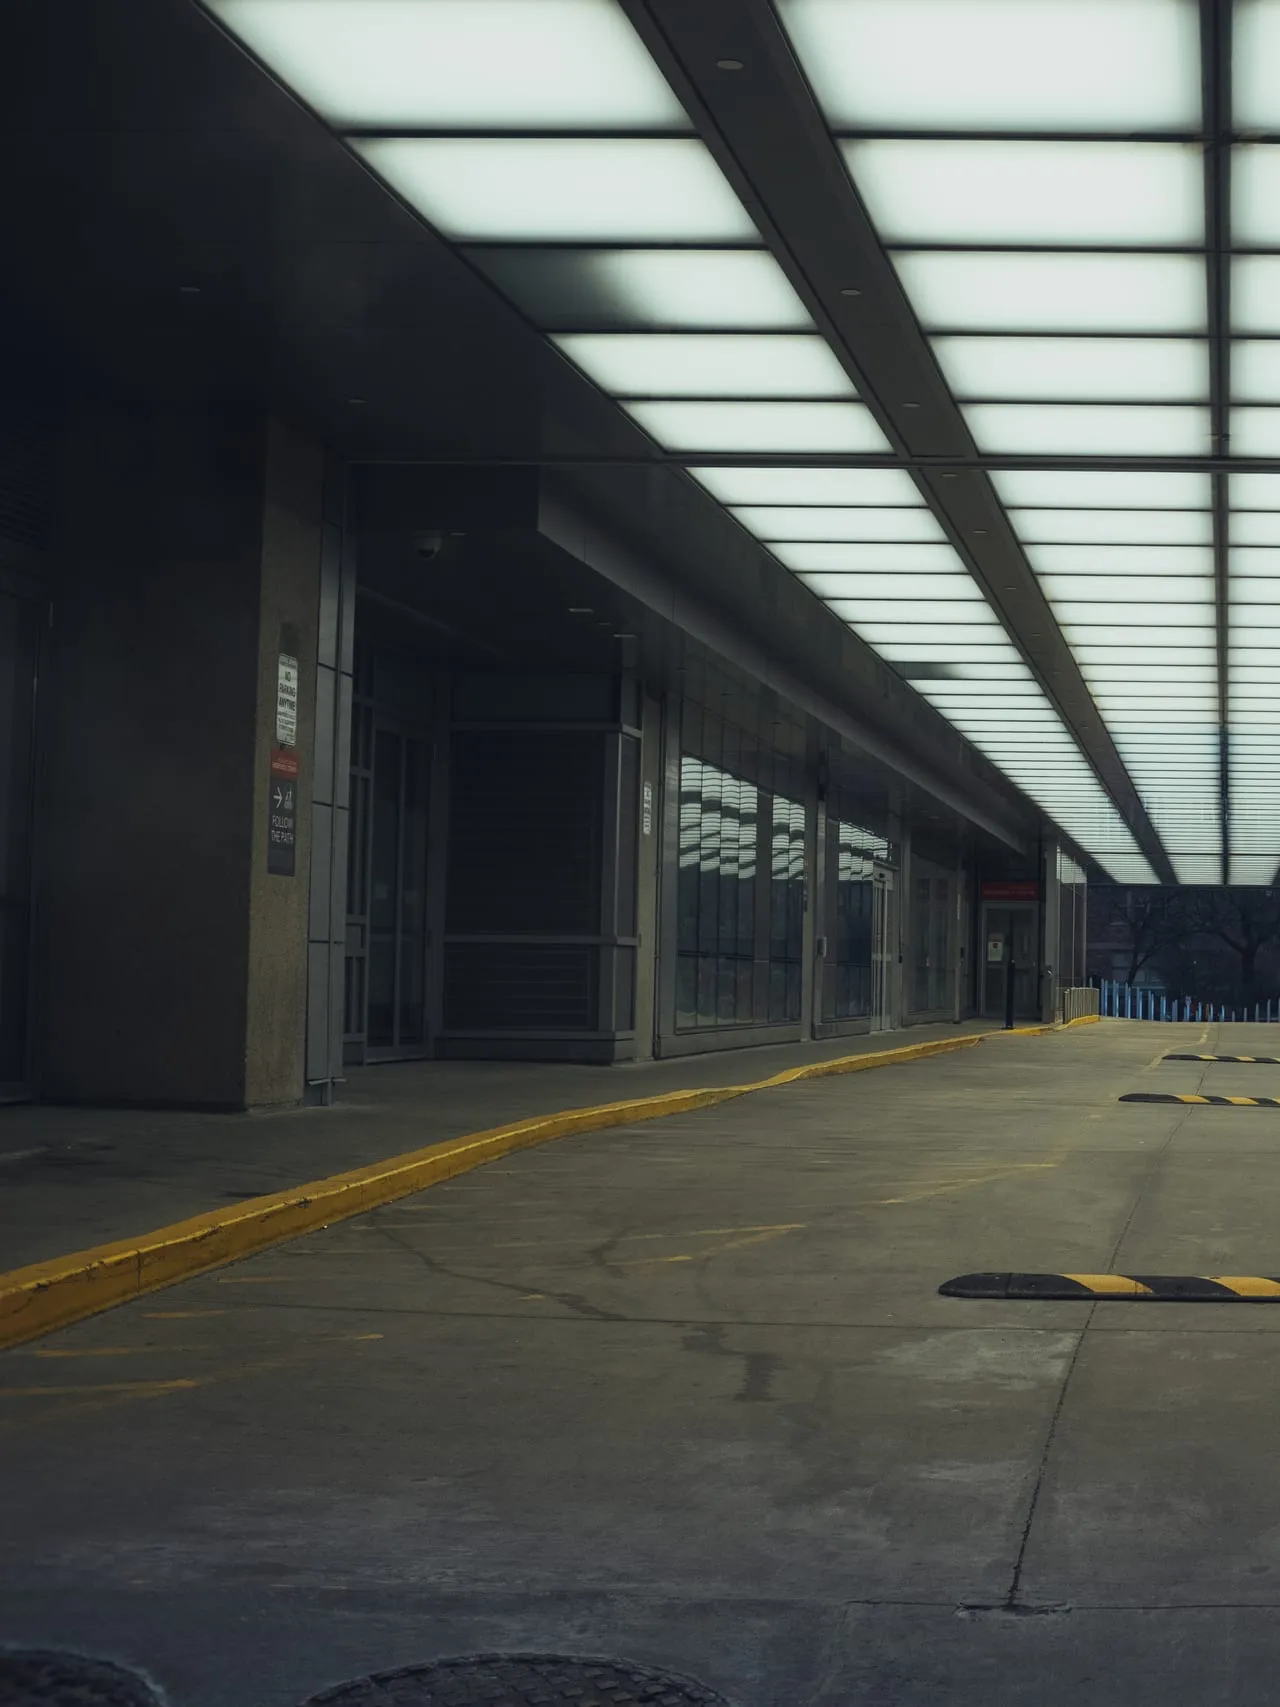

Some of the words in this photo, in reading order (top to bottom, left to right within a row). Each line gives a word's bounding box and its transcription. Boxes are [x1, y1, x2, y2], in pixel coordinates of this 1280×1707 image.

[272, 814, 293, 829] FOLLOW
[272, 830, 281, 843] THE
[281, 831, 294, 845] PATH
